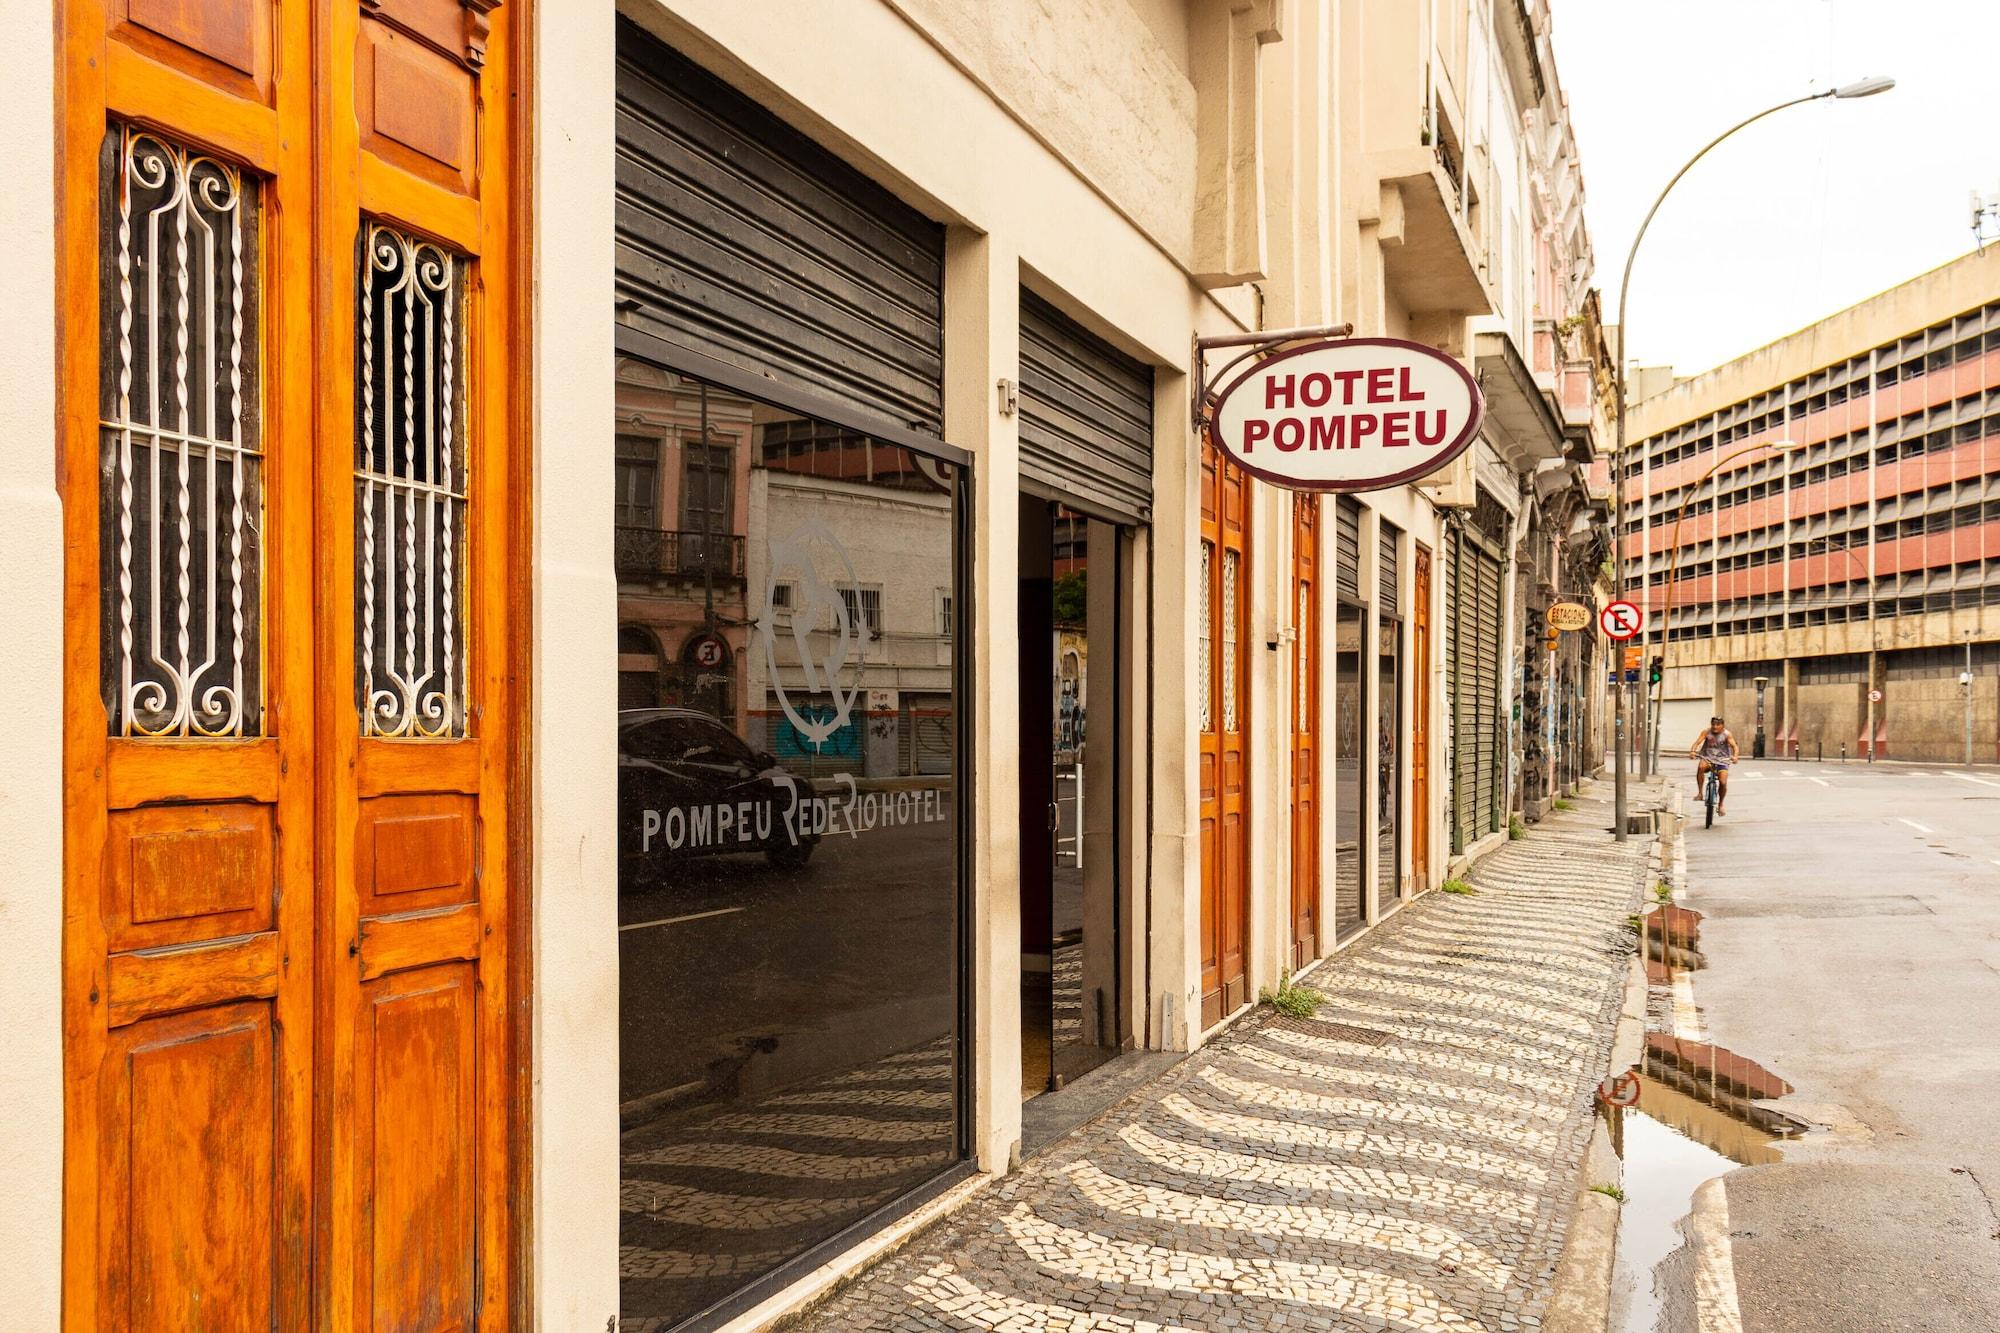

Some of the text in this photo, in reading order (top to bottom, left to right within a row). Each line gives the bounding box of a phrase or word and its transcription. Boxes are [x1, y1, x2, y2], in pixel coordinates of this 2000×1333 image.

[1265, 366, 1425, 410] HOTEL
[1243, 409, 1447, 454] POMPEU
[1614, 609, 1629, 631] E
[643, 800, 772, 852] POMPEU
[881, 790, 945, 827] HOTEL
